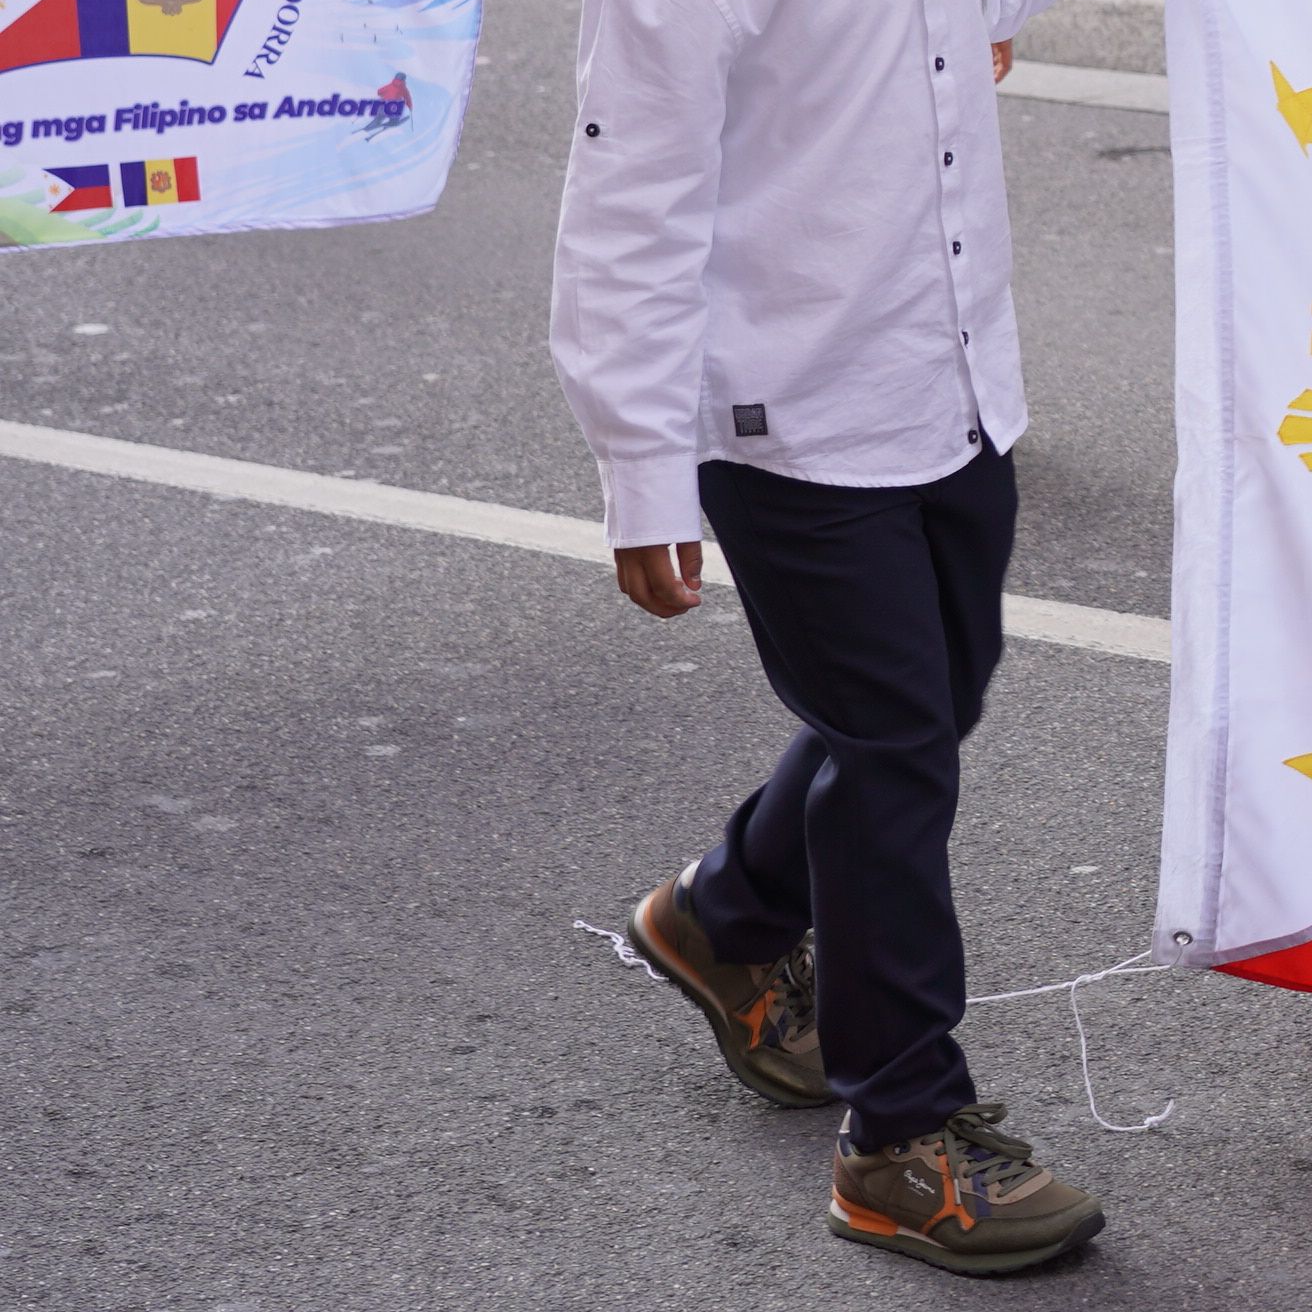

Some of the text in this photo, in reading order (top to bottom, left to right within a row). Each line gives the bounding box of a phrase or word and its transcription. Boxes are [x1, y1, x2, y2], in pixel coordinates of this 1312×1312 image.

[31, 105, 107, 142] mga
[114, 99, 228, 134] Filipino
[233, 101, 268, 122] sa
[273, 93, 406, 119] Andorra
